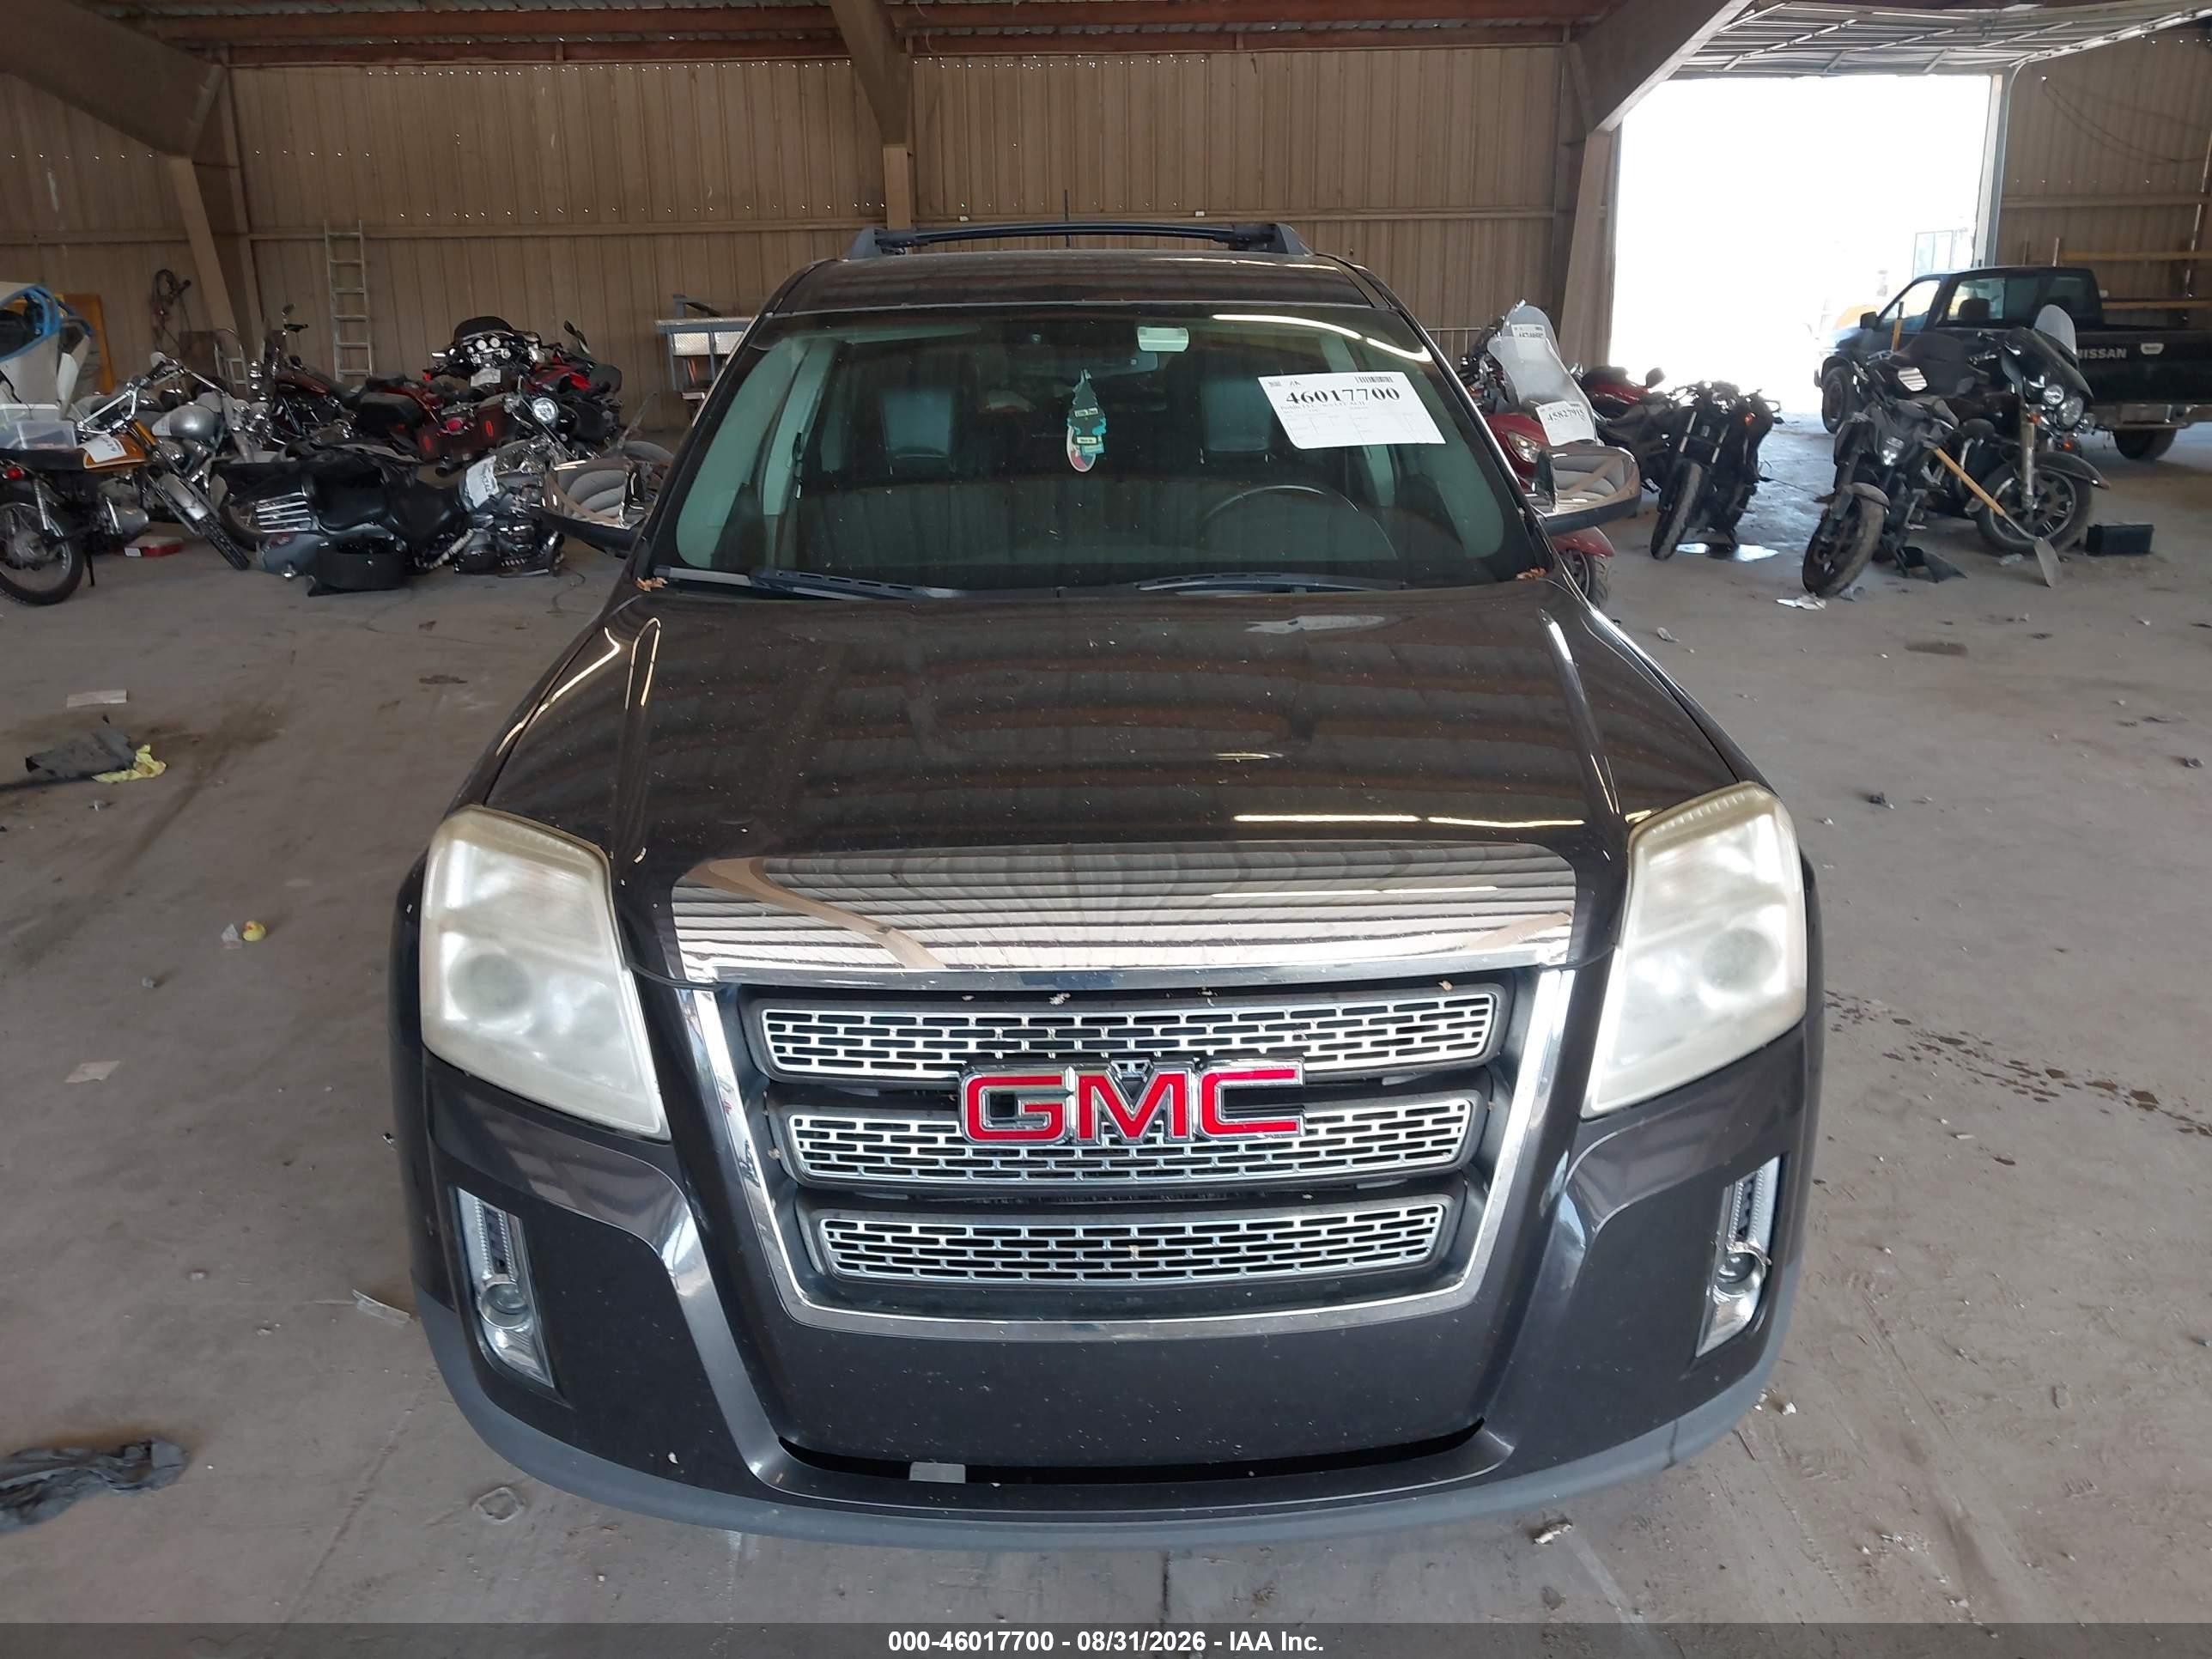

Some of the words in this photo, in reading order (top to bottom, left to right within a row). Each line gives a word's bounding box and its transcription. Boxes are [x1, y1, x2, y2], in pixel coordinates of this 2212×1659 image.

[2075, 348, 2127, 359] NISSAN
[1285, 386, 1401, 404] 46017700
[961, 1060, 1304, 1144] GMC
